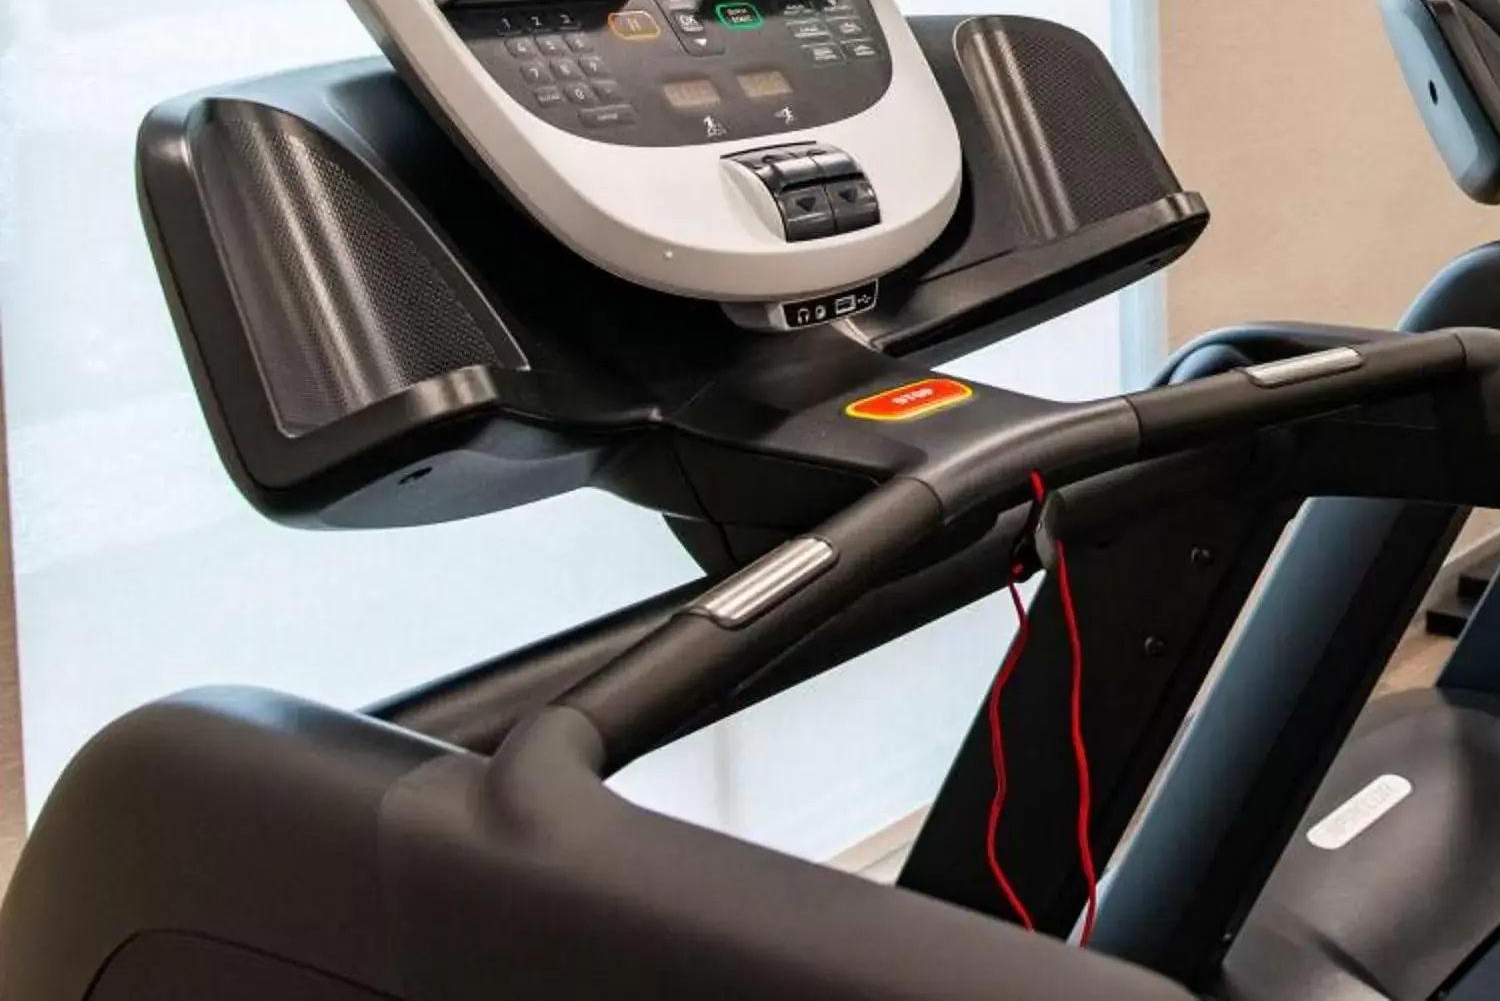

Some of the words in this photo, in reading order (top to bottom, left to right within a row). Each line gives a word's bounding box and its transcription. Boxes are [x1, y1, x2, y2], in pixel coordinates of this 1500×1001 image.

[531, 16, 542, 26] 2
[530, 67, 539, 79] 7
[891, 387, 934, 405] STOP
